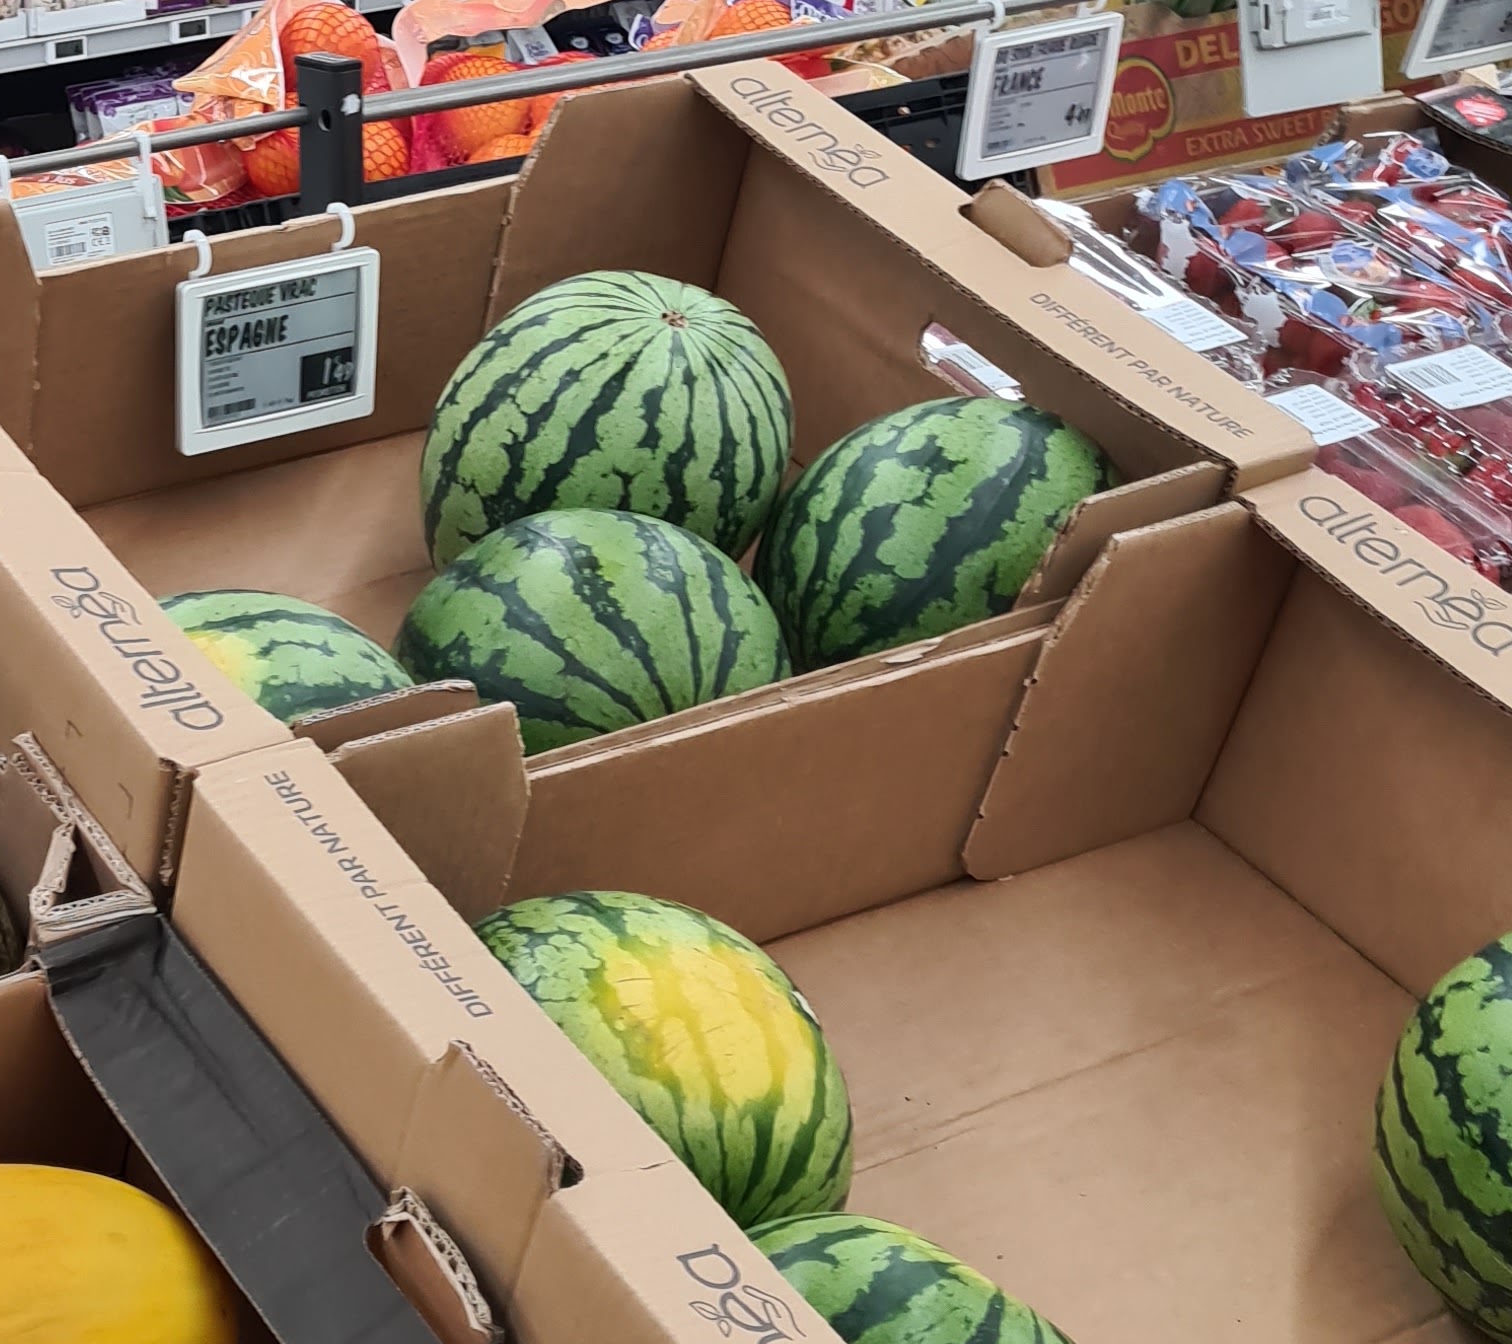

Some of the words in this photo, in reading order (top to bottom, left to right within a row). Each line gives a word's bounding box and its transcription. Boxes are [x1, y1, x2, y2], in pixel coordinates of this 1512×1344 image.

[1185, 127, 1250, 157] EXTRA
[1254, 114, 1317, 145] SWEET
[204, 314, 290, 358] ESPAGNE
[1029, 292, 1138, 362] DIFFÉRENT
[1127, 359, 1174, 389] PAR
[1166, 385, 1256, 440] NATURE
[263, 768, 350, 855] NATURE
[337, 855, 388, 900] PAR
[374, 903, 494, 1019] DIFFÉRENT
